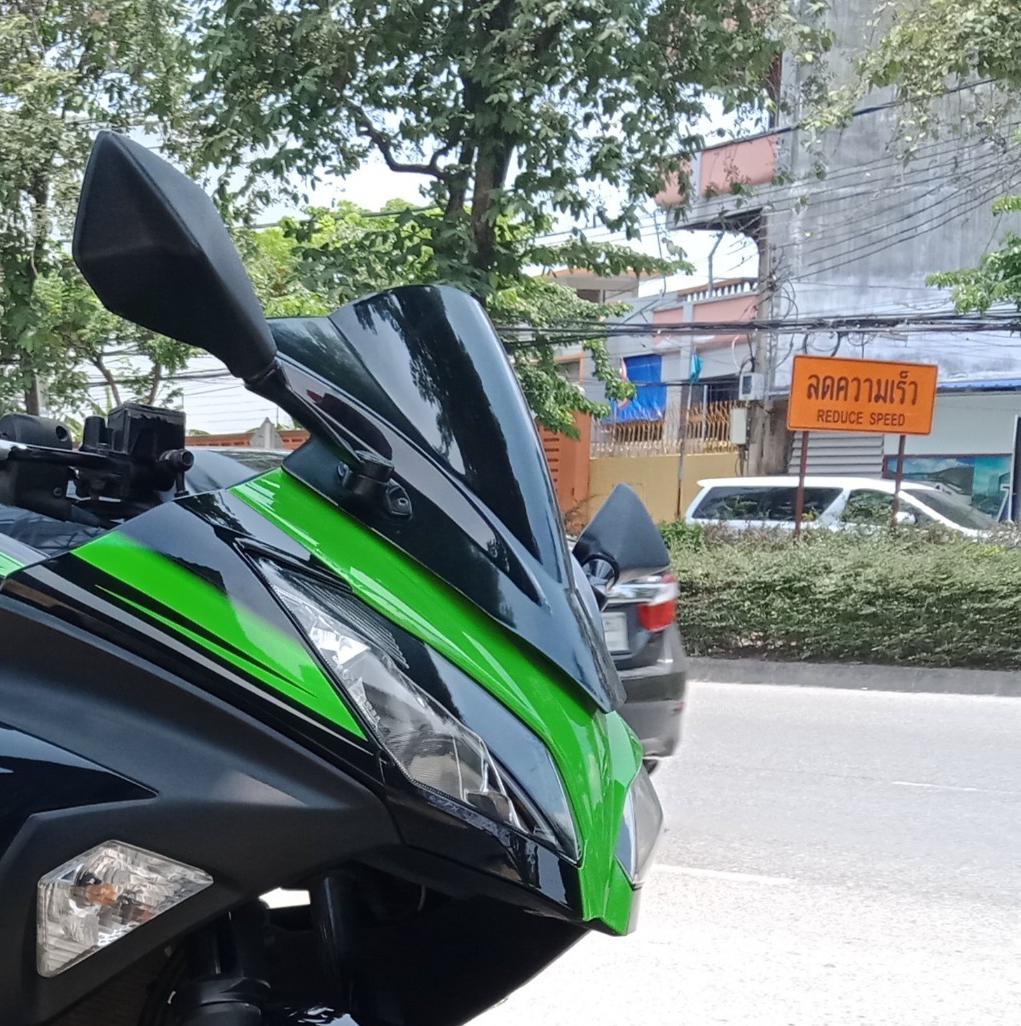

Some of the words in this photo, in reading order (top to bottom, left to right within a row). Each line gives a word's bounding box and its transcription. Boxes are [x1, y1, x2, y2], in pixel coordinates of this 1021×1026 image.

[807, 370, 919, 405] ลดความเร็ว
[817, 409, 863, 425] REDUCE
[869, 412, 906, 427] SPEED
